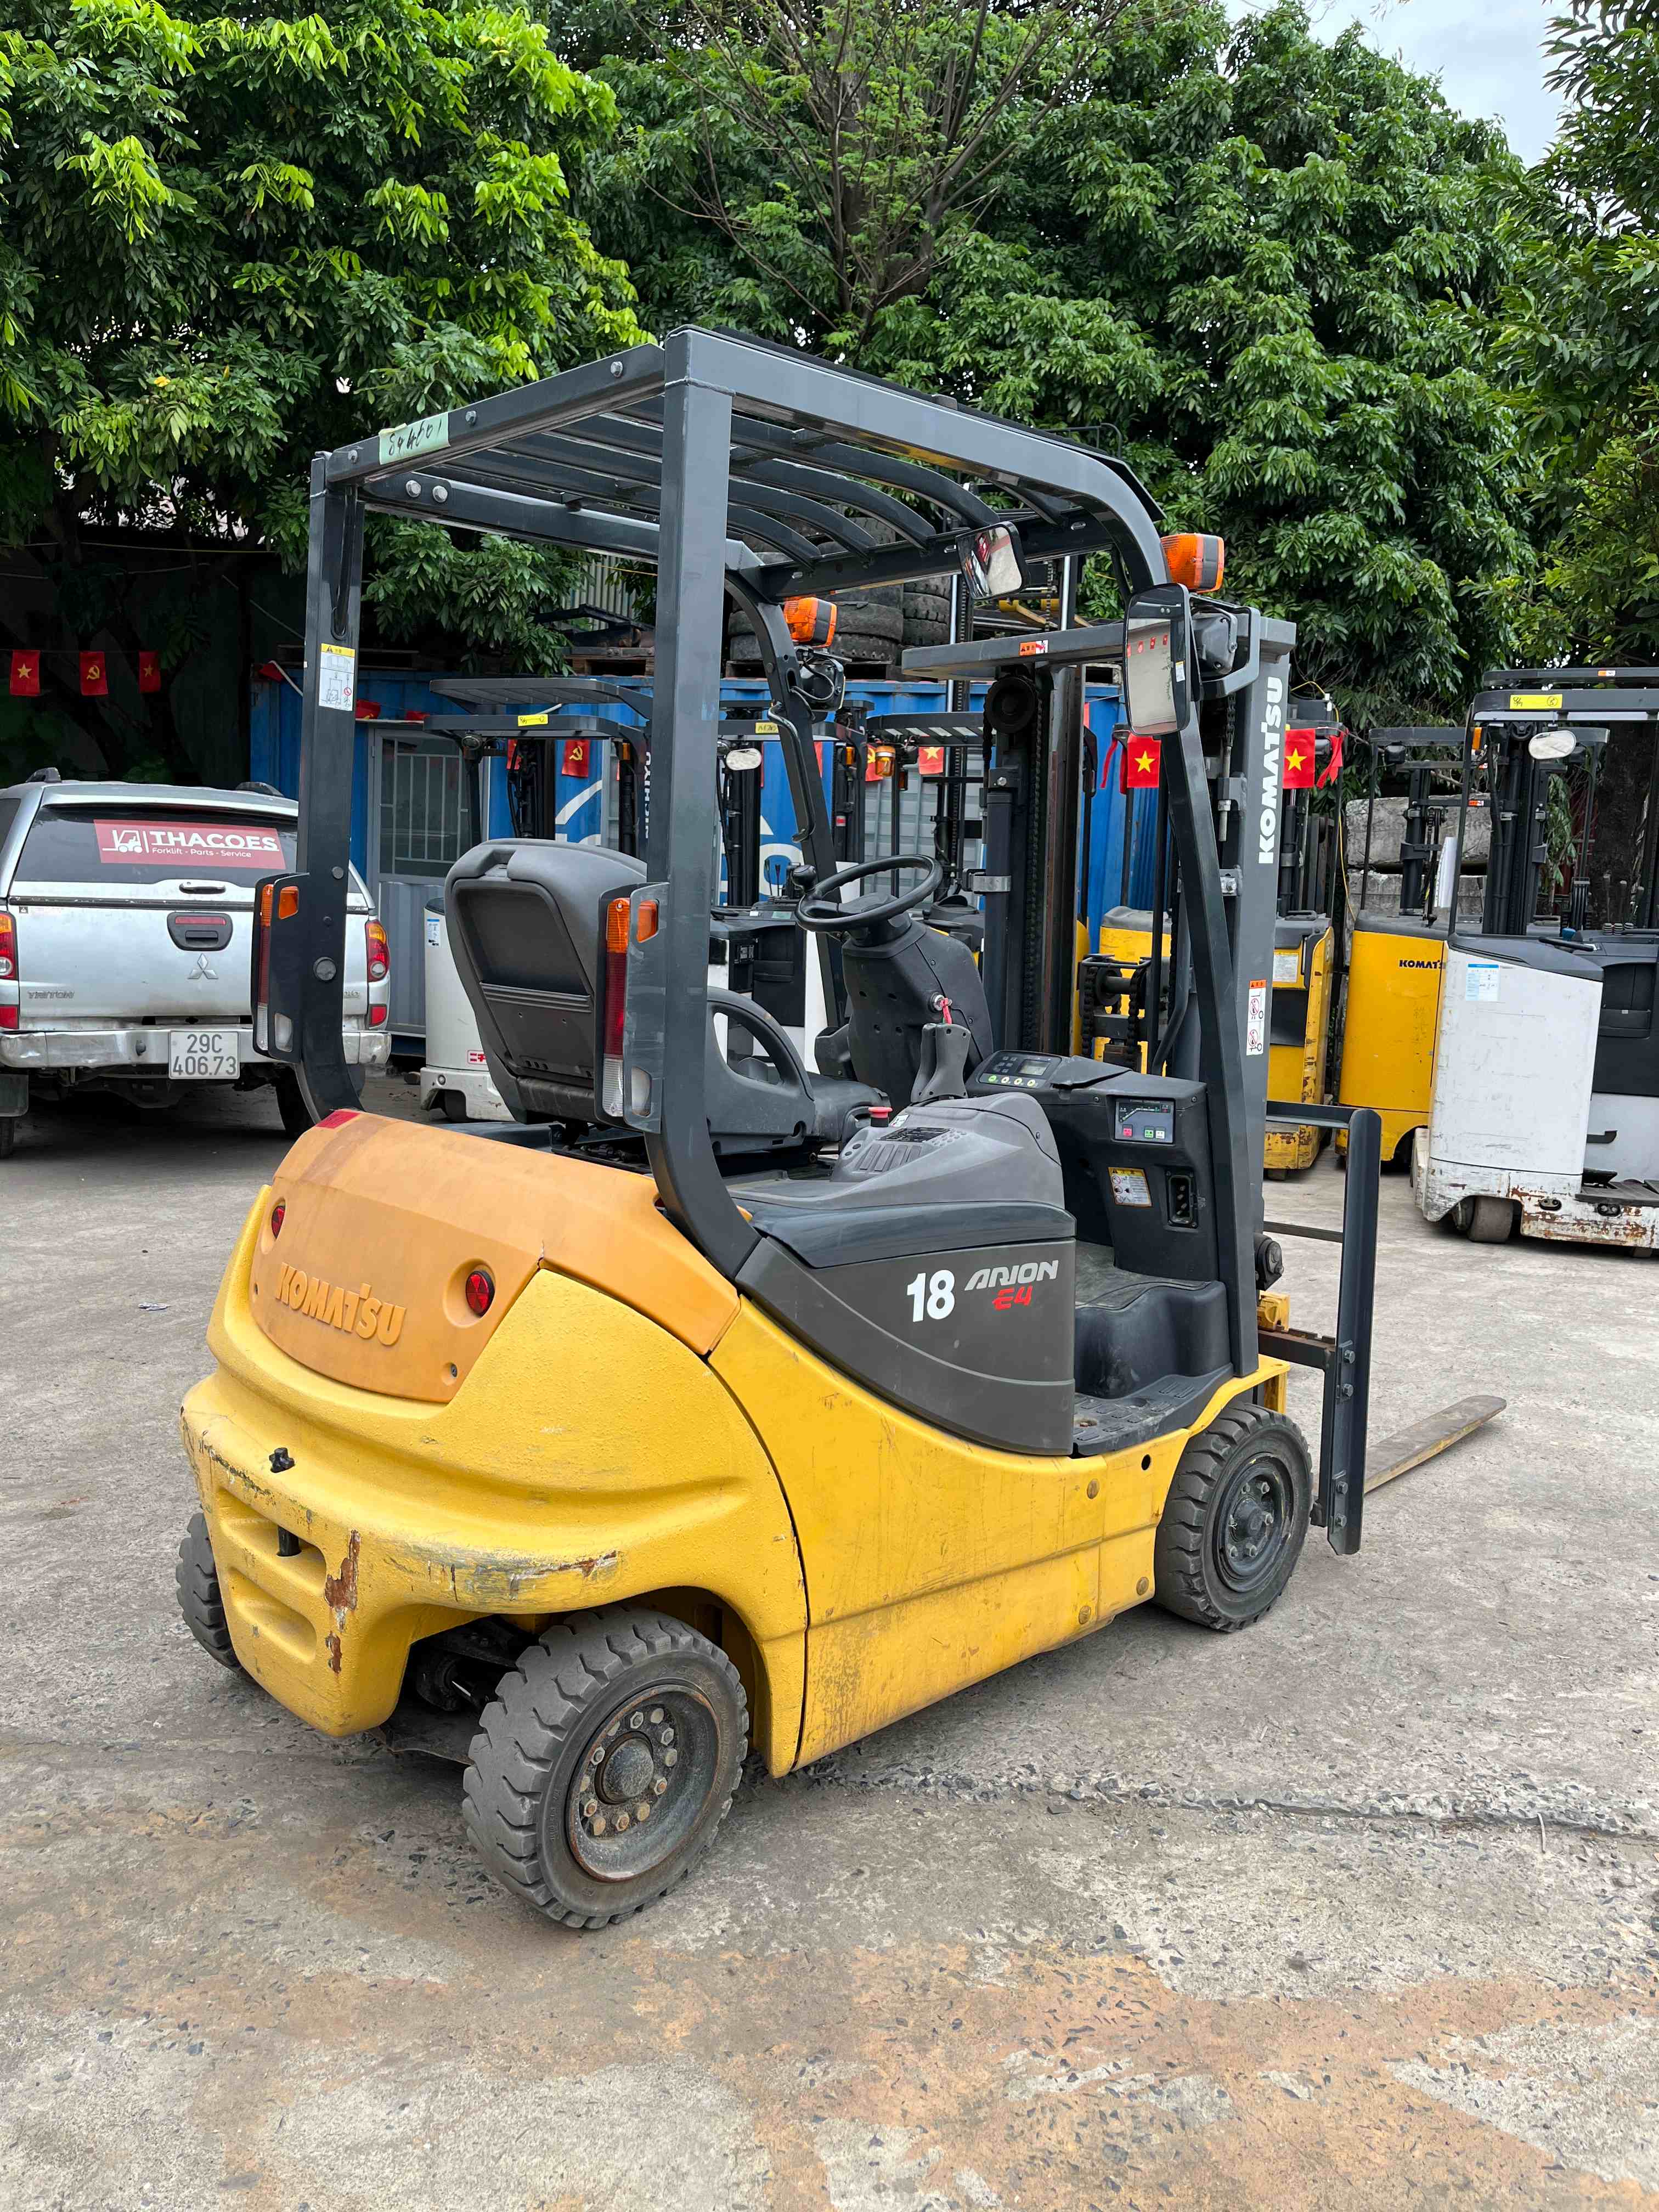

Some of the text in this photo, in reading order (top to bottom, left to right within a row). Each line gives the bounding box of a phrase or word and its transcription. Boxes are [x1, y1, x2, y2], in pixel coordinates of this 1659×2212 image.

[1258, 676, 1283, 864] KOMATSU
[150, 831, 279, 851] THACOES
[28, 991, 75, 999] TRITON
[187, 1034, 222, 1053] 29C
[173, 1056, 236, 1075] 406.73
[907, 1260, 1059, 1322] 18 ARION
[992, 1285, 1032, 1310] E4
[275, 1262, 407, 1346] KOMATSU
